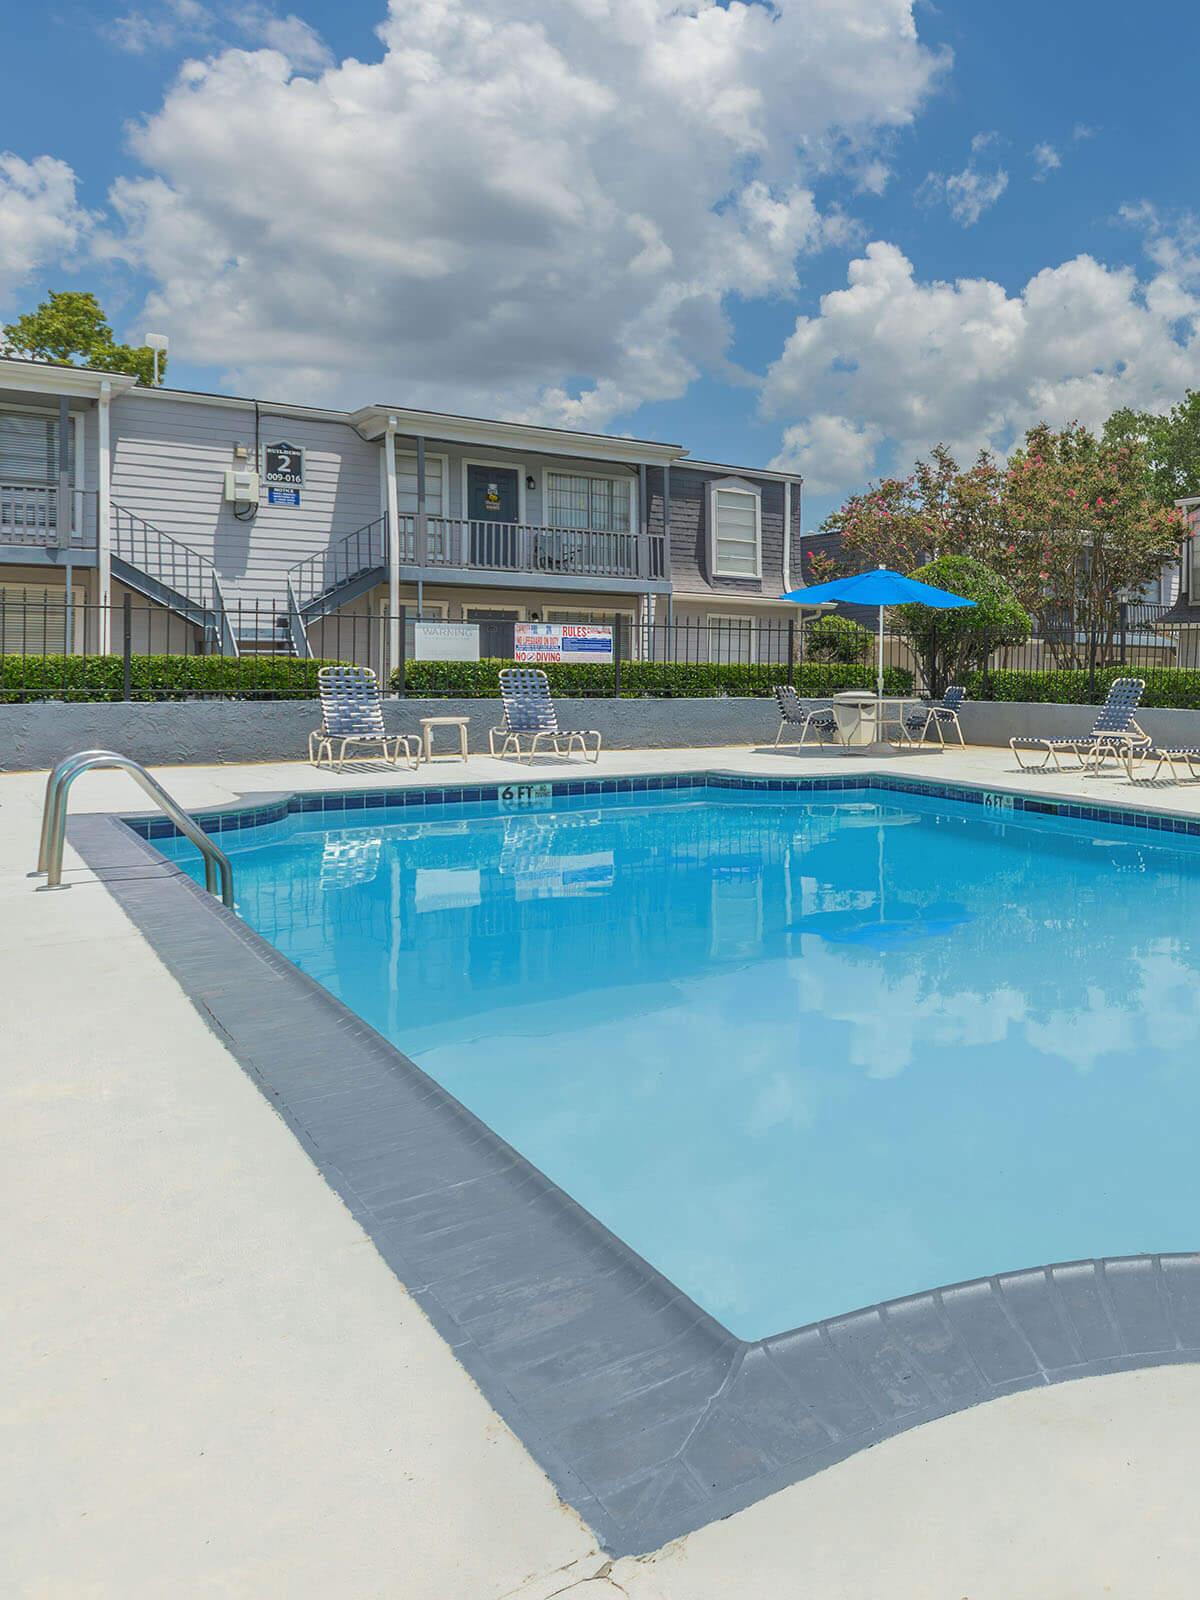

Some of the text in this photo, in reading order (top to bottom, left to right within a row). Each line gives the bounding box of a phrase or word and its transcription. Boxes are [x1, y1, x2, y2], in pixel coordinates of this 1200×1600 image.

[277, 455, 291, 472] 2
[267, 473, 302, 483] 009-016
[423, 628, 473, 637] WARNING
[516, 652, 527, 661] NO
[536, 652, 561, 662] DIVING
[502, 786, 514, 800] 6
[518, 785, 534, 800] FT
[985, 793, 992, 806] 6
[994, 795, 1003, 808] FT
